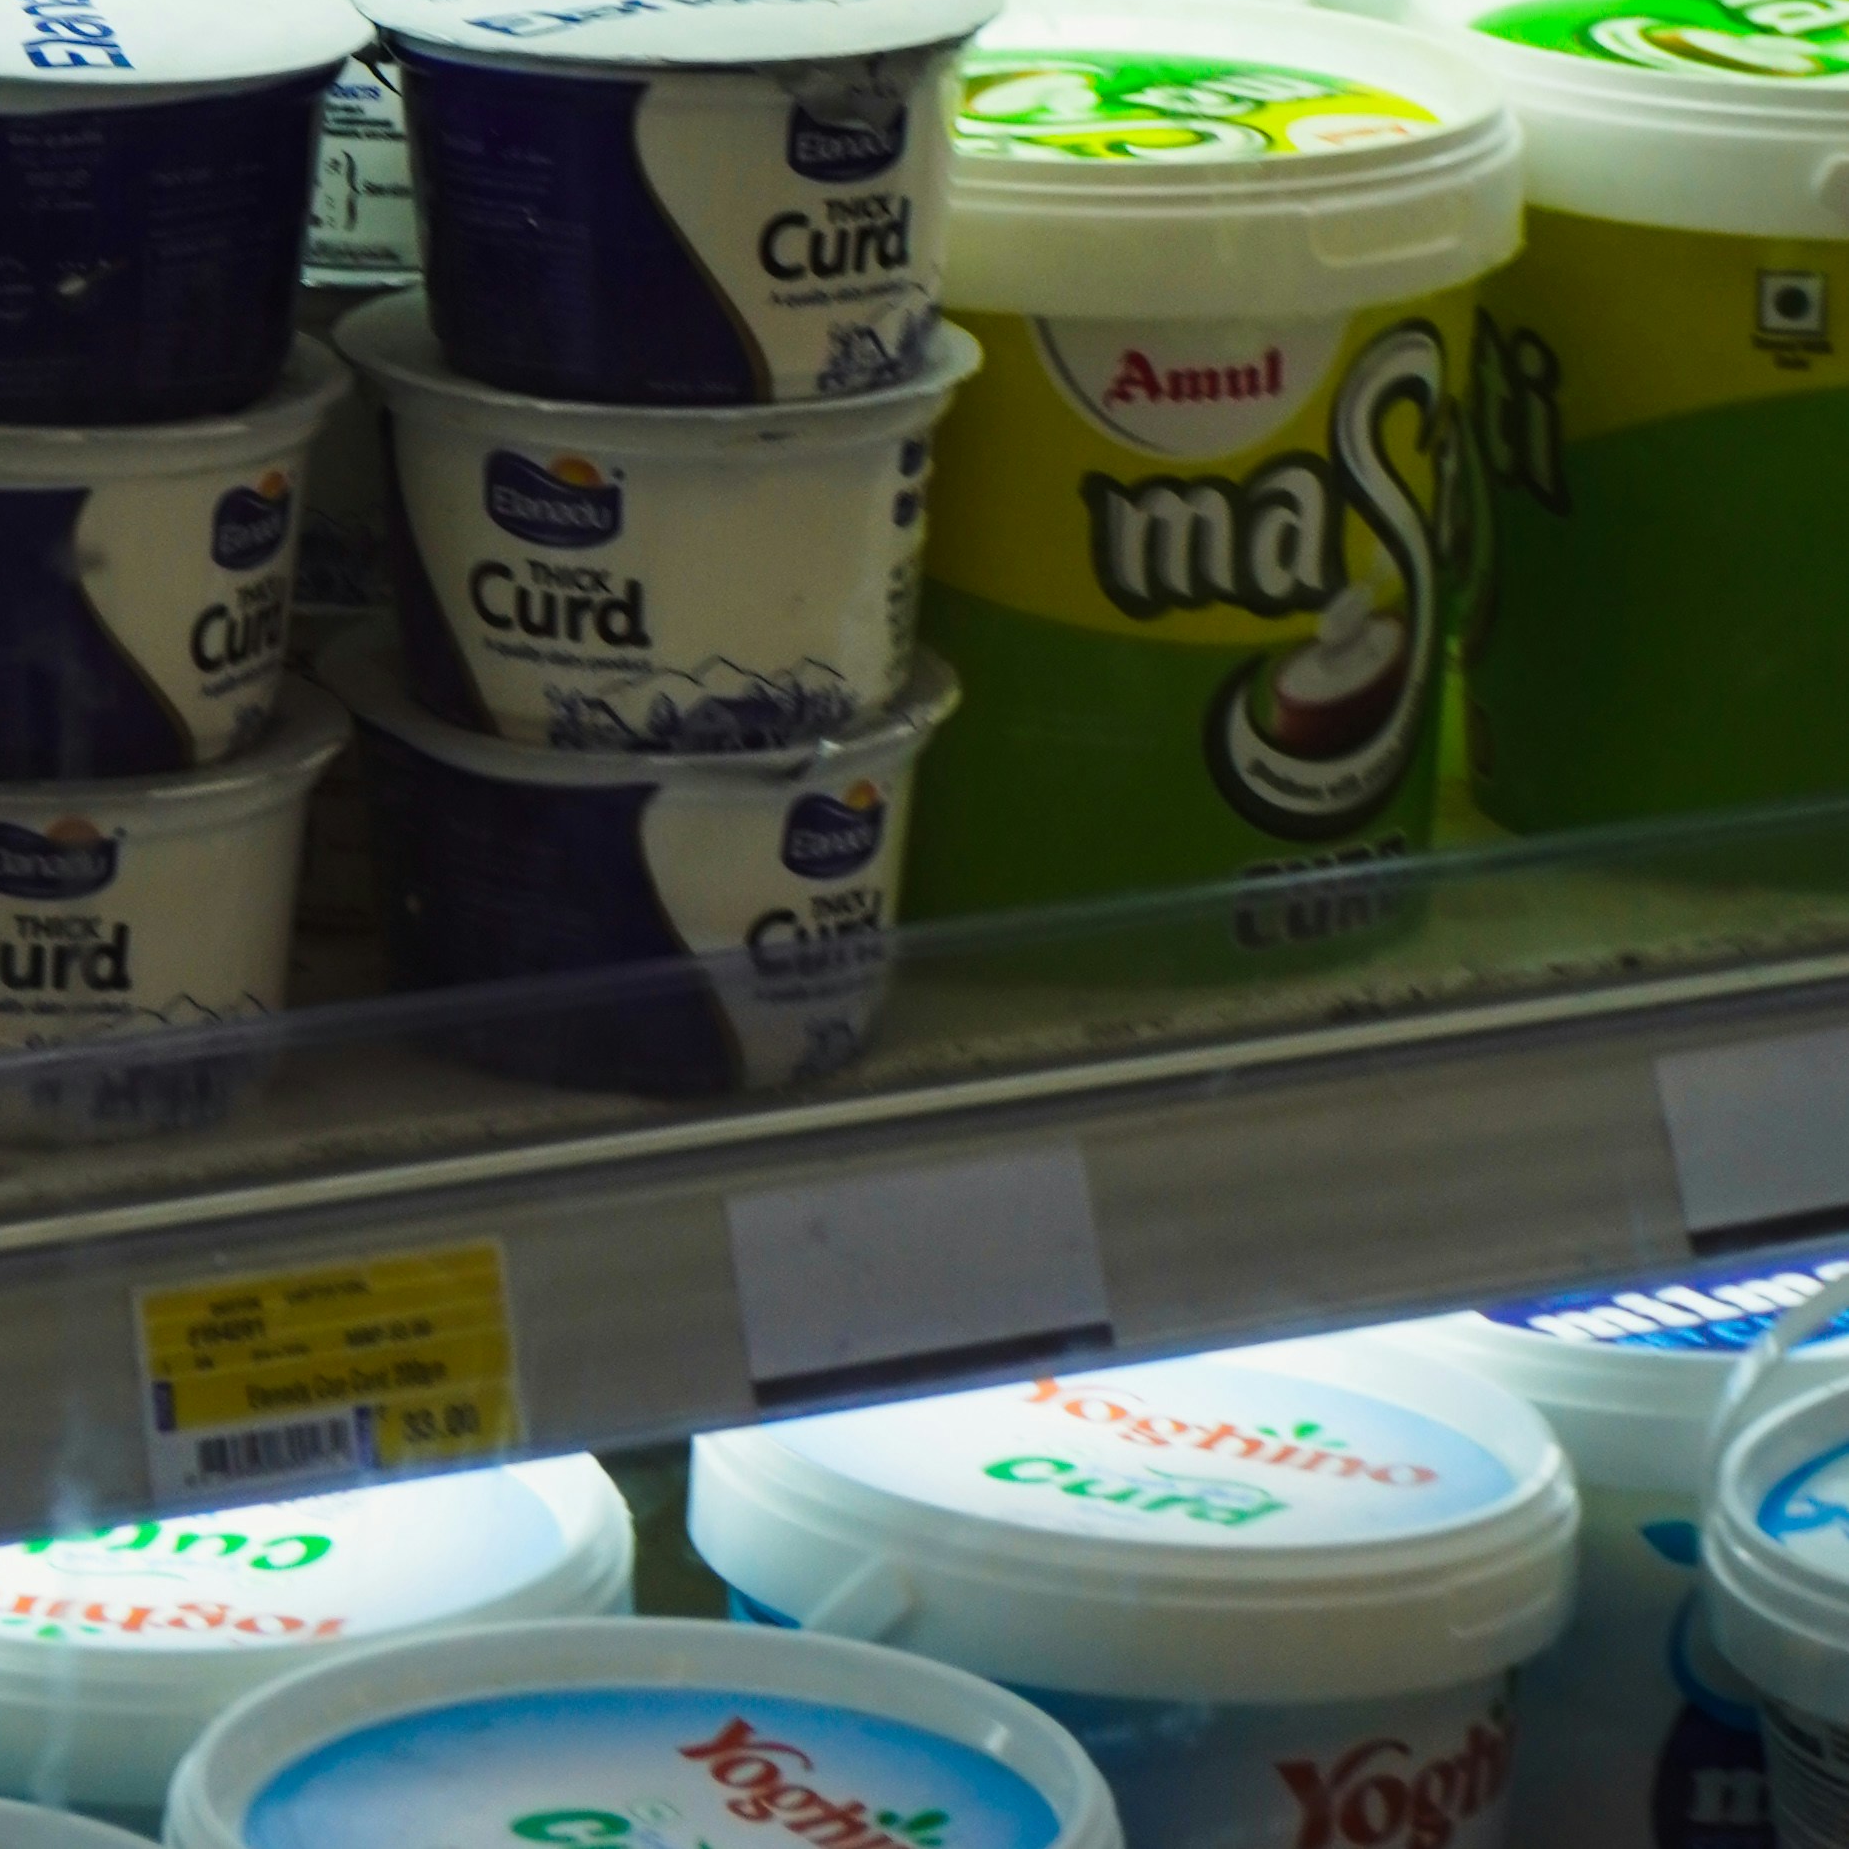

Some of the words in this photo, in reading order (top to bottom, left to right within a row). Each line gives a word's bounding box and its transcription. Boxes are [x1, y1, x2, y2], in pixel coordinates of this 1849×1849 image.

[758, 196, 910, 281] Curd
[1104, 347, 1286, 408] Amul
[467, 559, 652, 649] Curd
[527, 558, 614, 595] THICK
[13, 912, 103, 942] THICK
[1024, 1376, 1442, 1491] Yoghino
[983, 1453, 1289, 1528] Curd
